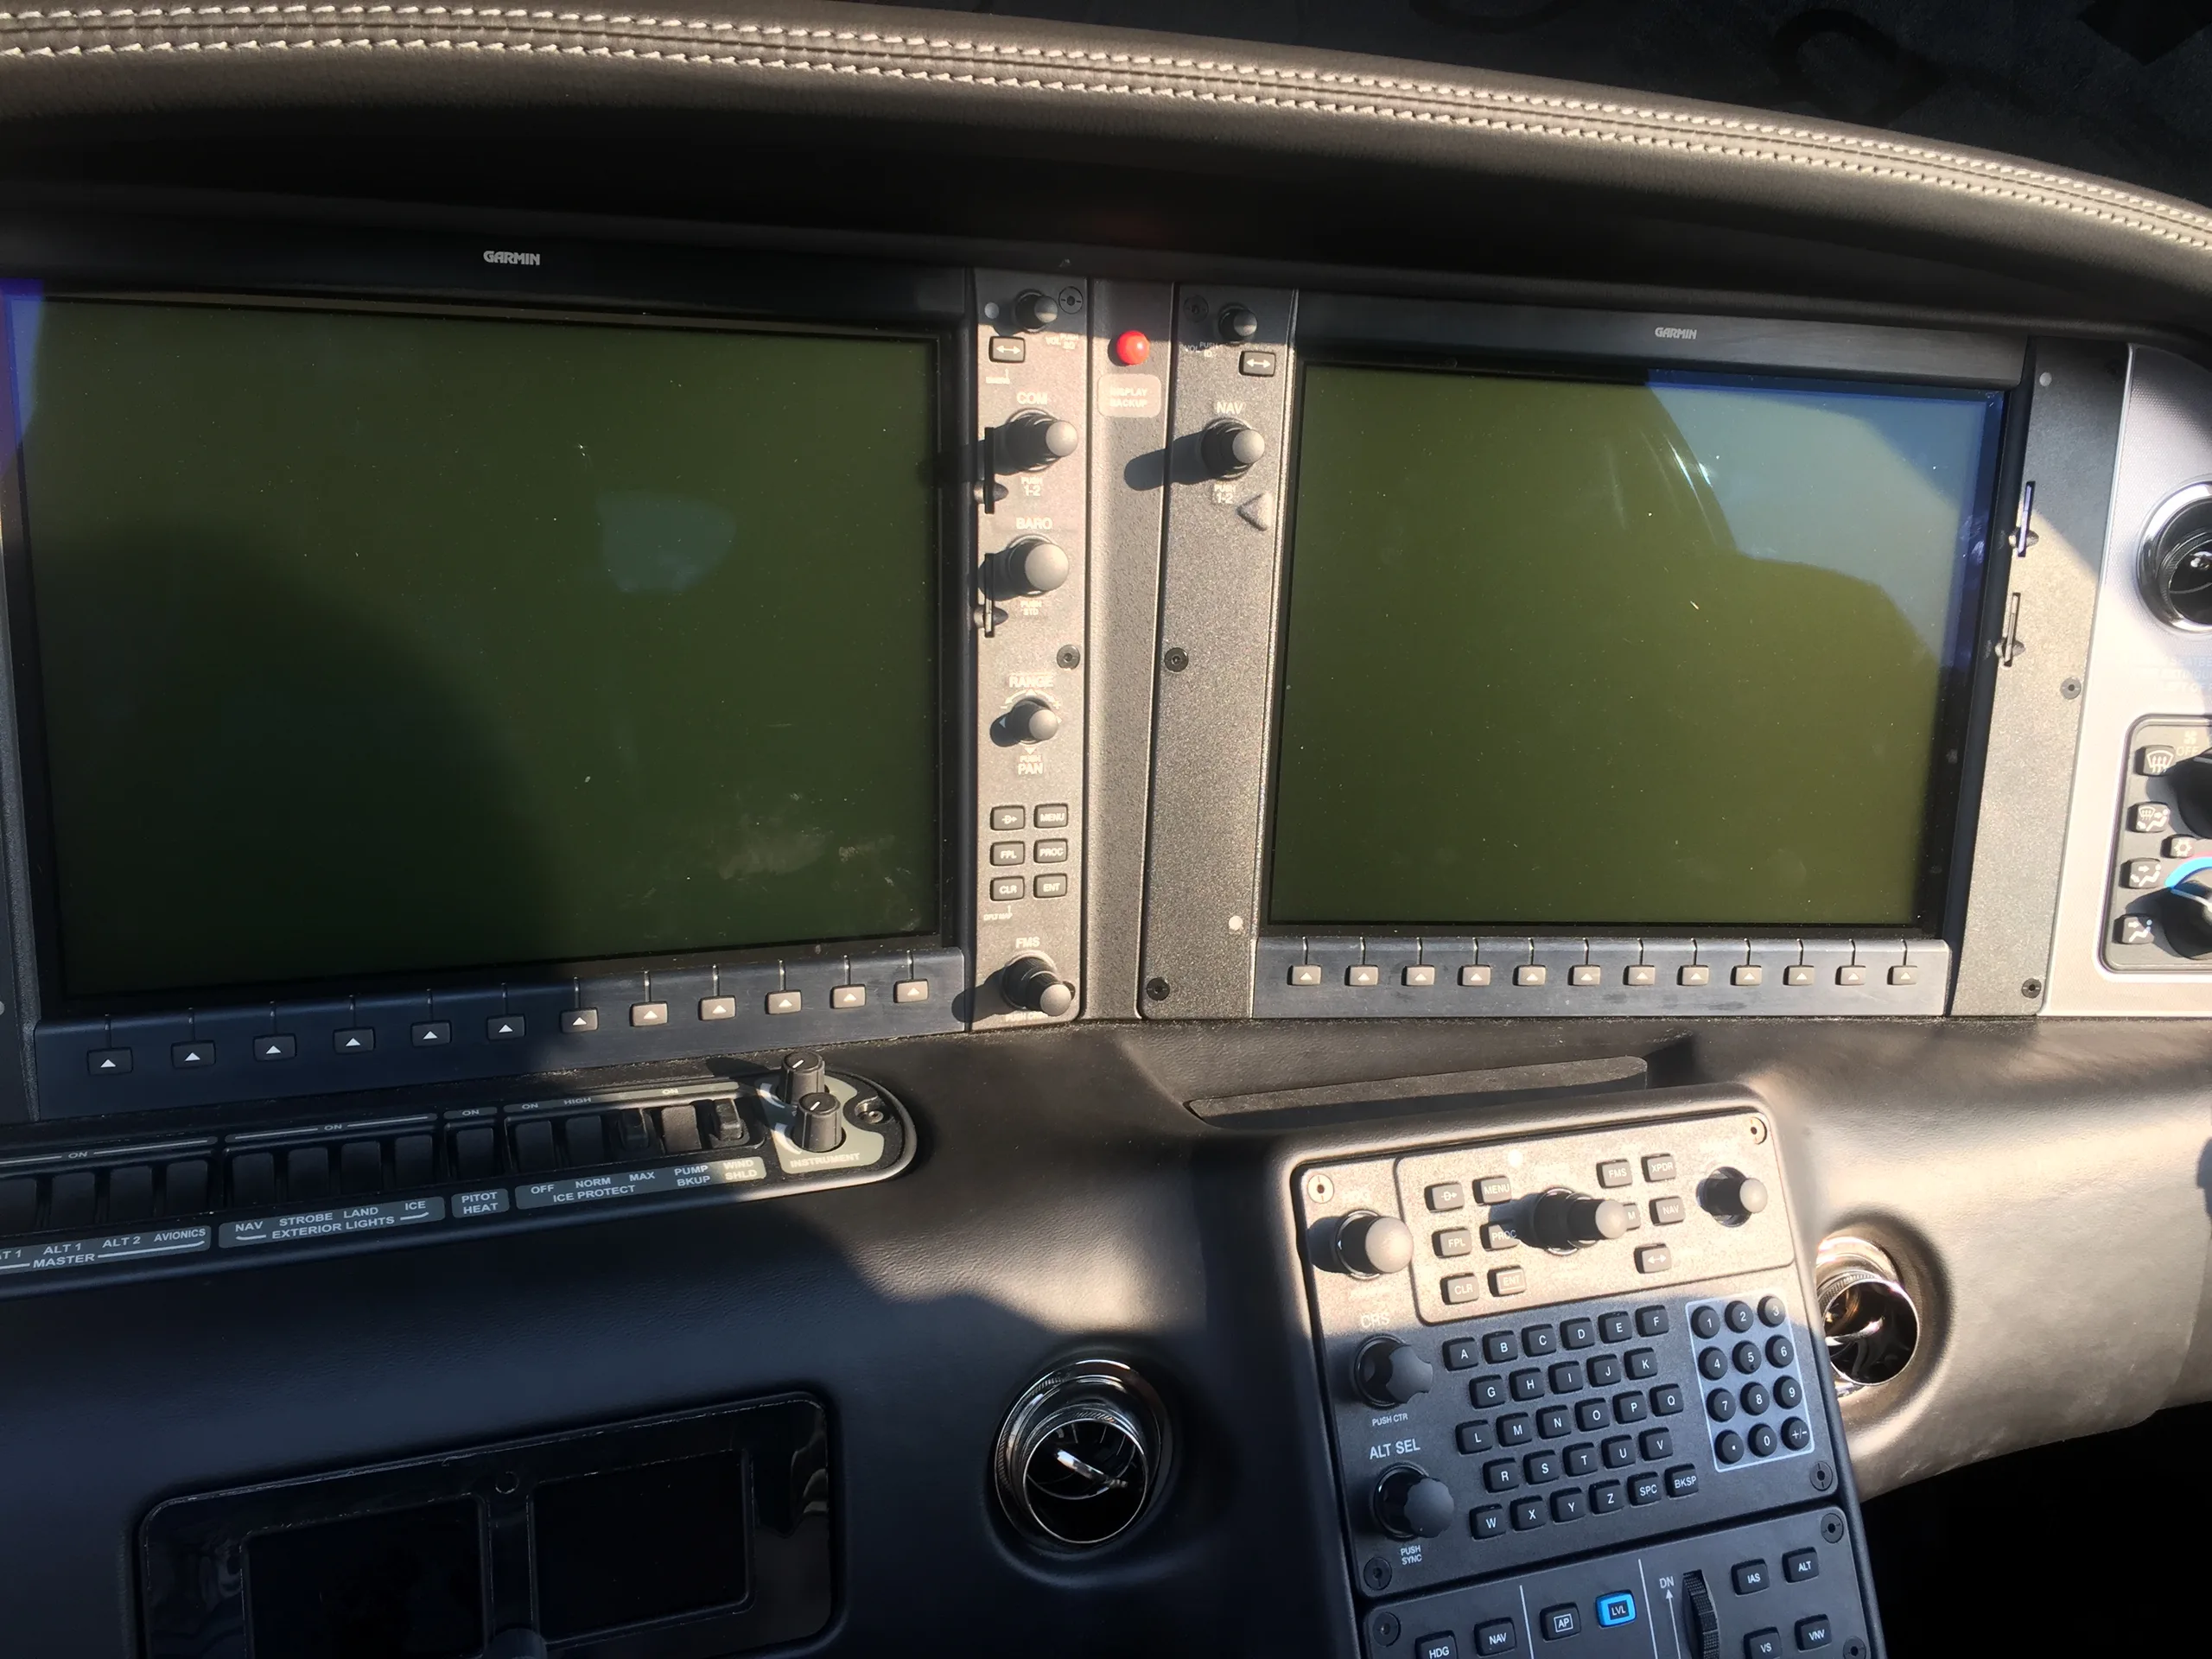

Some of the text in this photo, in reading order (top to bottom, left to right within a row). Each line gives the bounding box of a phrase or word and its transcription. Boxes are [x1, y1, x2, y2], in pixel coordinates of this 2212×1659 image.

[483, 251, 541, 265] GARMIN
[1654, 327, 1698, 340] GARMIN
[1016, 391, 1048, 405] COM
[1215, 401, 1244, 415] NAV
[1015, 517, 1053, 530] BARO
[1017, 762, 1044, 776] PAN
[1039, 813, 1065, 823] MENU
[1000, 850, 1018, 860] FPL
[1039, 848, 1065, 858] PROC
[999, 885, 1018, 895] CLR
[1042, 882, 1061, 893] ENT
[1015, 936, 1041, 949] FMS
[563, 1096, 592, 1105] HIGH
[67, 1151, 89, 1160] ON
[790, 1153, 861, 1168] INSTRUMENT
[674, 1164, 709, 1176] PUMP
[722, 1159, 755, 1170] WIND
[1651, 1162, 1674, 1173] XPDR
[725, 1169, 758, 1180] SHLD
[1608, 1167, 1627, 1179] FMS
[531, 1171, 656, 1195] OFF NORM MAX
[677, 1175, 711, 1187] BKUP
[553, 1185, 636, 1203] ICE PROTECT
[1483, 1183, 1510, 1195] MENU
[461, 1192, 499, 1204] PITOT
[463, 1202, 499, 1215] HEAT
[1662, 1205, 1680, 1215] NAV
[235, 1200, 426, 1232] NAV STROBE LAND ICE
[271, 1216, 395, 1239] EXTERIOR LIGHTS
[154, 1228, 207, 1243] AVIONICS
[1491, 1229, 1517, 1242] PROC
[102, 1236, 141, 1248] ALT 2
[1447, 1237, 1466, 1249] FPL
[15, 1249, 22, 1258] 1
[43, 1243, 81, 1255] ALT 1
[33, 1253, 95, 1268] MASTER
[1503, 1275, 1522, 1287] ENT
[1454, 1283, 1474, 1295] CLR
[1739, 1311, 1747, 1322] 2
[1773, 1306, 1780, 1316] 3
[1360, 1313, 1390, 1328] CRS
[1652, 1316, 1660, 1327] F
[1707, 1318, 1713, 1328] 1
[1577, 1328, 1586, 1339] D
[1615, 1322, 1624, 1333] E
[1539, 1334, 1548, 1346] C
[1500, 1342, 1509, 1353] B
[1780, 1345, 1788, 1357] 6
[1460, 1349, 1469, 1359] A
[1747, 1351, 1755, 1363] 5
[1642, 1358, 1649, 1370] K
[1713, 1358, 1721, 1370] 4
[1605, 1365, 1611, 1376] J
[1526, 1379, 1535, 1390] H
[1487, 1386, 1496, 1398] G
[1789, 1387, 1796, 1398] 9
[1667, 1395, 1675, 1406] Q
[1721, 1400, 1728, 1411] 7
[1756, 1394, 1763, 1405] 8
[1630, 1402, 1637, 1413] P
[1371, 1412, 1409, 1427] PUSH CTR
[1553, 1417, 1562, 1428] N
[1513, 1424, 1523, 1436] M
[1474, 1433, 1482, 1443] L
[1370, 1439, 1421, 1460] ALT SEL
[1656, 1440, 1663, 1450] V
[1618, 1447, 1627, 1459] U
[1580, 1454, 1587, 1465] T
[1541, 1463, 1549, 1474] S
[1501, 1471, 1510, 1482] R
[1674, 1475, 1697, 1489] BKSP
[1639, 1484, 1658, 1497] SPC
[1606, 1492, 1615, 1504] Z
[1567, 1502, 1575, 1512] Y
[1528, 1509, 1536, 1520] X
[1485, 1516, 1497, 1529] W
[1400, 1545, 1421, 1556] PUSH
[1402, 1554, 1422, 1566] SYNC
[1798, 1560, 1812, 1572] ALT
[1659, 1575, 1675, 1589] DN
[1747, 1573, 1761, 1584] IAS
[1611, 1605, 1626, 1616] LVL
[1558, 1618, 1570, 1629] AP
[1489, 1632, 1507, 1645] NAV
[1808, 1629, 1825, 1641] VNV
[1428, 1646, 1450, 1659] HDG
[1760, 1642, 1772, 1653] VS
